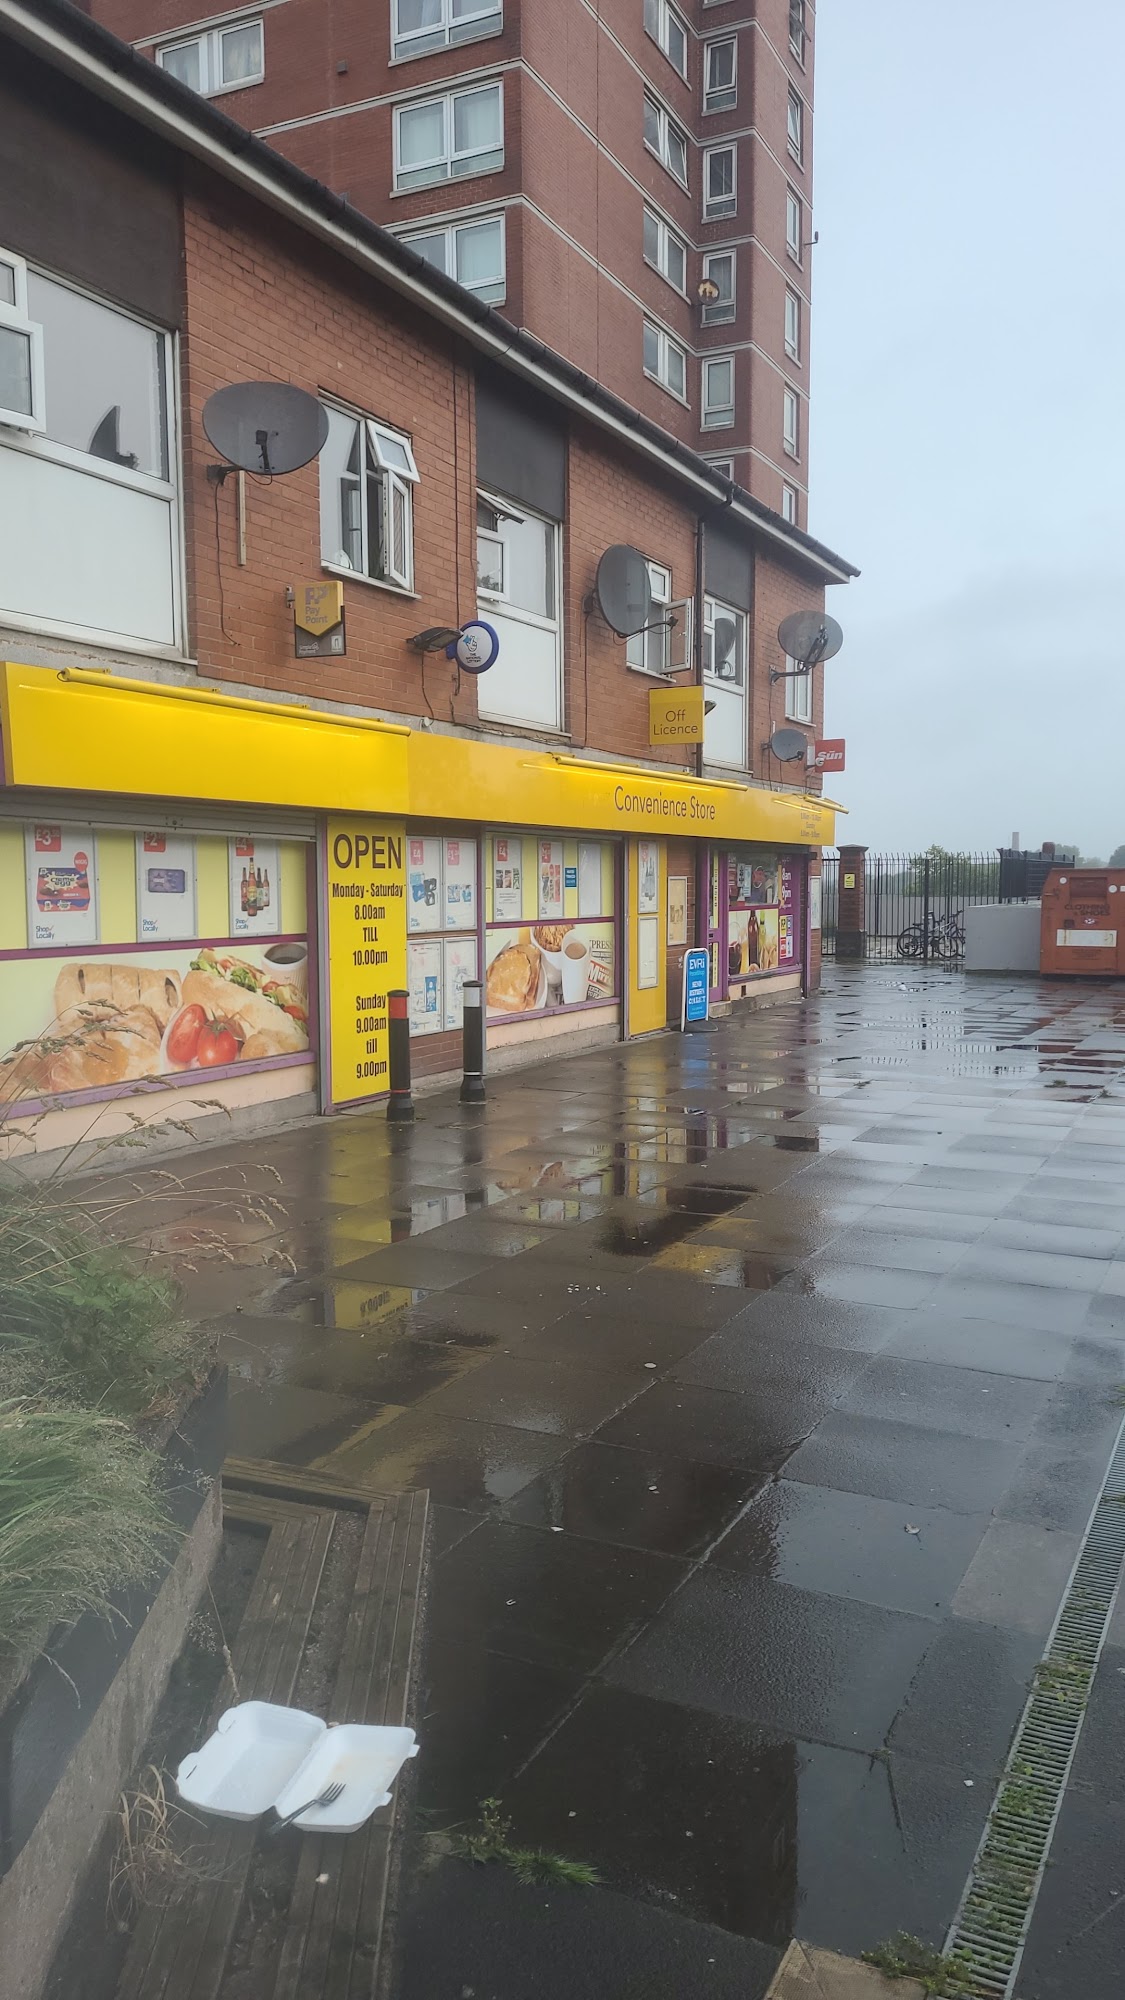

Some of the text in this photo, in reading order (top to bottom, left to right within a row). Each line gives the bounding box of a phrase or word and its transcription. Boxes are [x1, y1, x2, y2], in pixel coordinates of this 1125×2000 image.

[305, 607, 320, 616] Pay
[305, 616, 328, 624] Point
[665, 709, 686, 722] Off
[653, 724, 698, 736] Licence
[614, 785, 716, 820] Convenience Store
[333, 833, 402, 869] OPEN
[332, 883, 364, 899] Monday
[370, 882, 403, 898] Saturday
[354, 904, 385, 920] 8.00am
[36, 925, 49, 934] Shop
[363, 927, 378, 942] TILL
[352, 949, 388, 966] 10.00pm
[356, 993, 386, 1011] Sunday
[356, 1016, 387, 1034] 9.00am
[366, 1038, 378, 1054] till
[356, 1060, 387, 1079] 9.00pm
